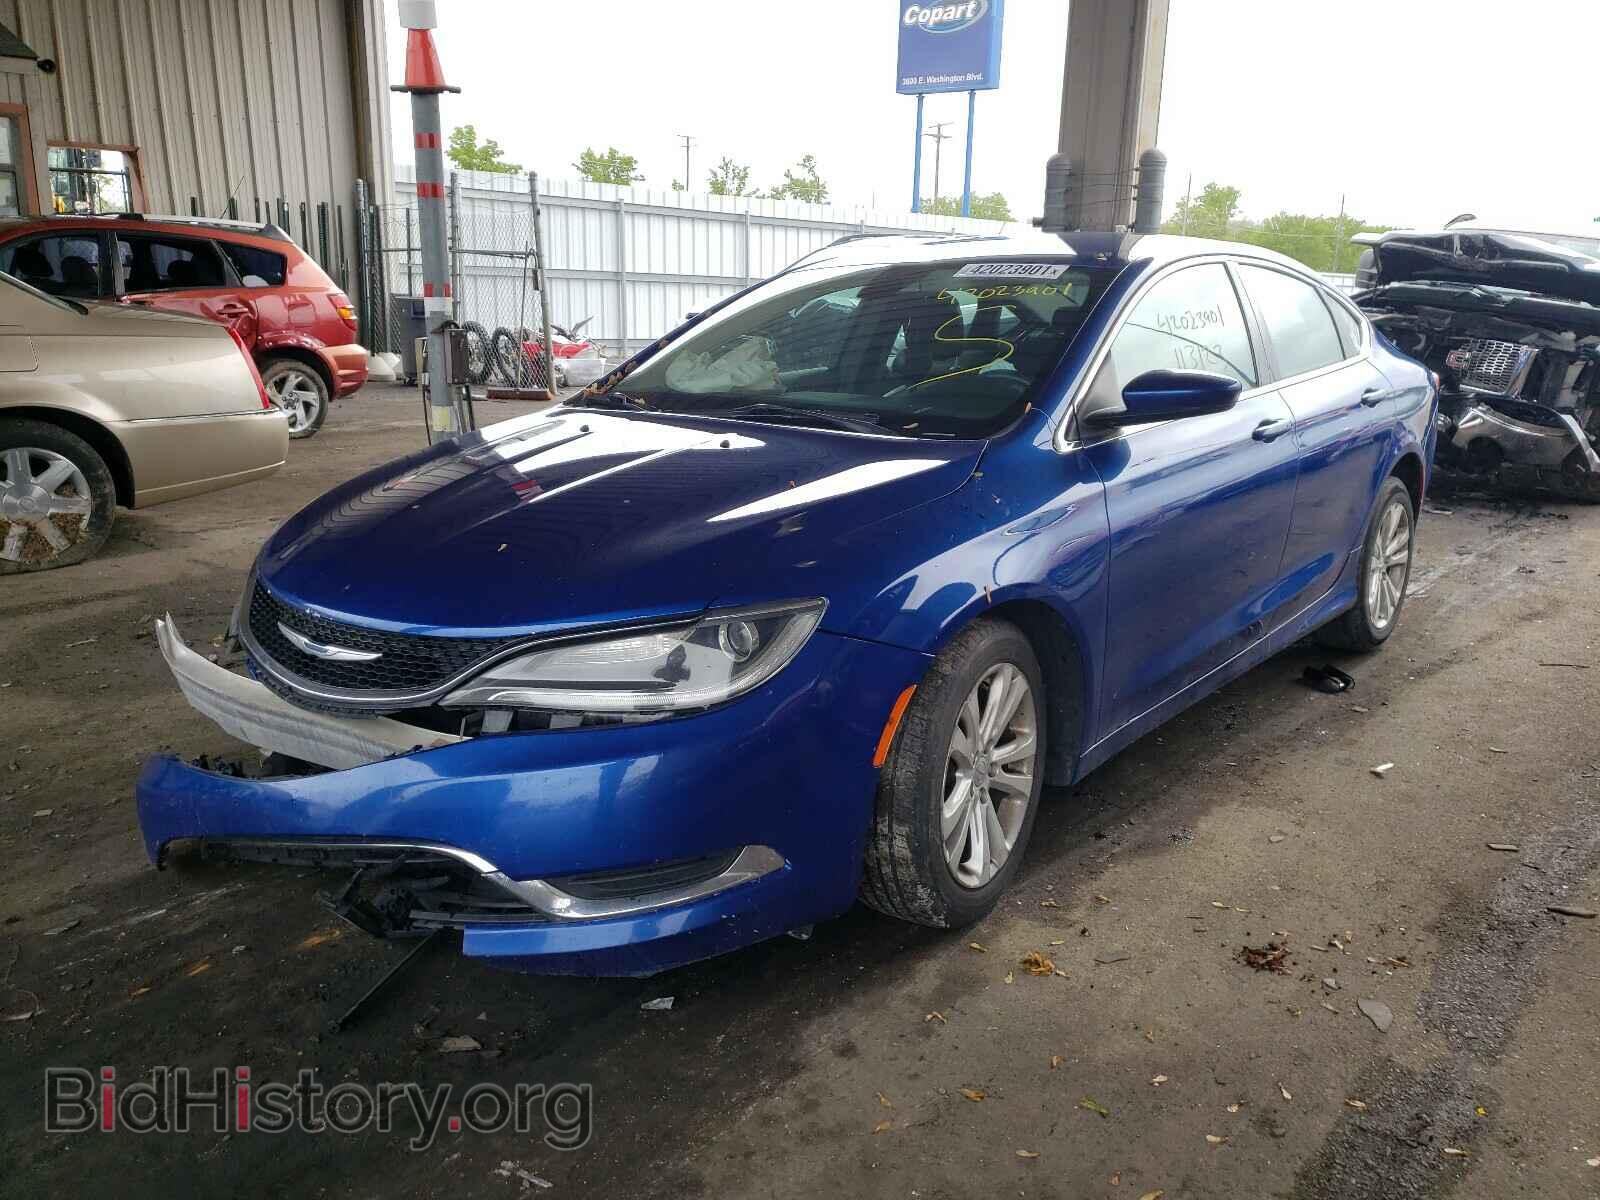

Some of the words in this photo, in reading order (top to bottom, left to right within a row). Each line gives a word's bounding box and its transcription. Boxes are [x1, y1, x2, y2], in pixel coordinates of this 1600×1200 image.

[904, 0, 978, 25] Copart
[927, 73, 965, 84] Washington
[1157, 304, 1225, 336] 42023901
